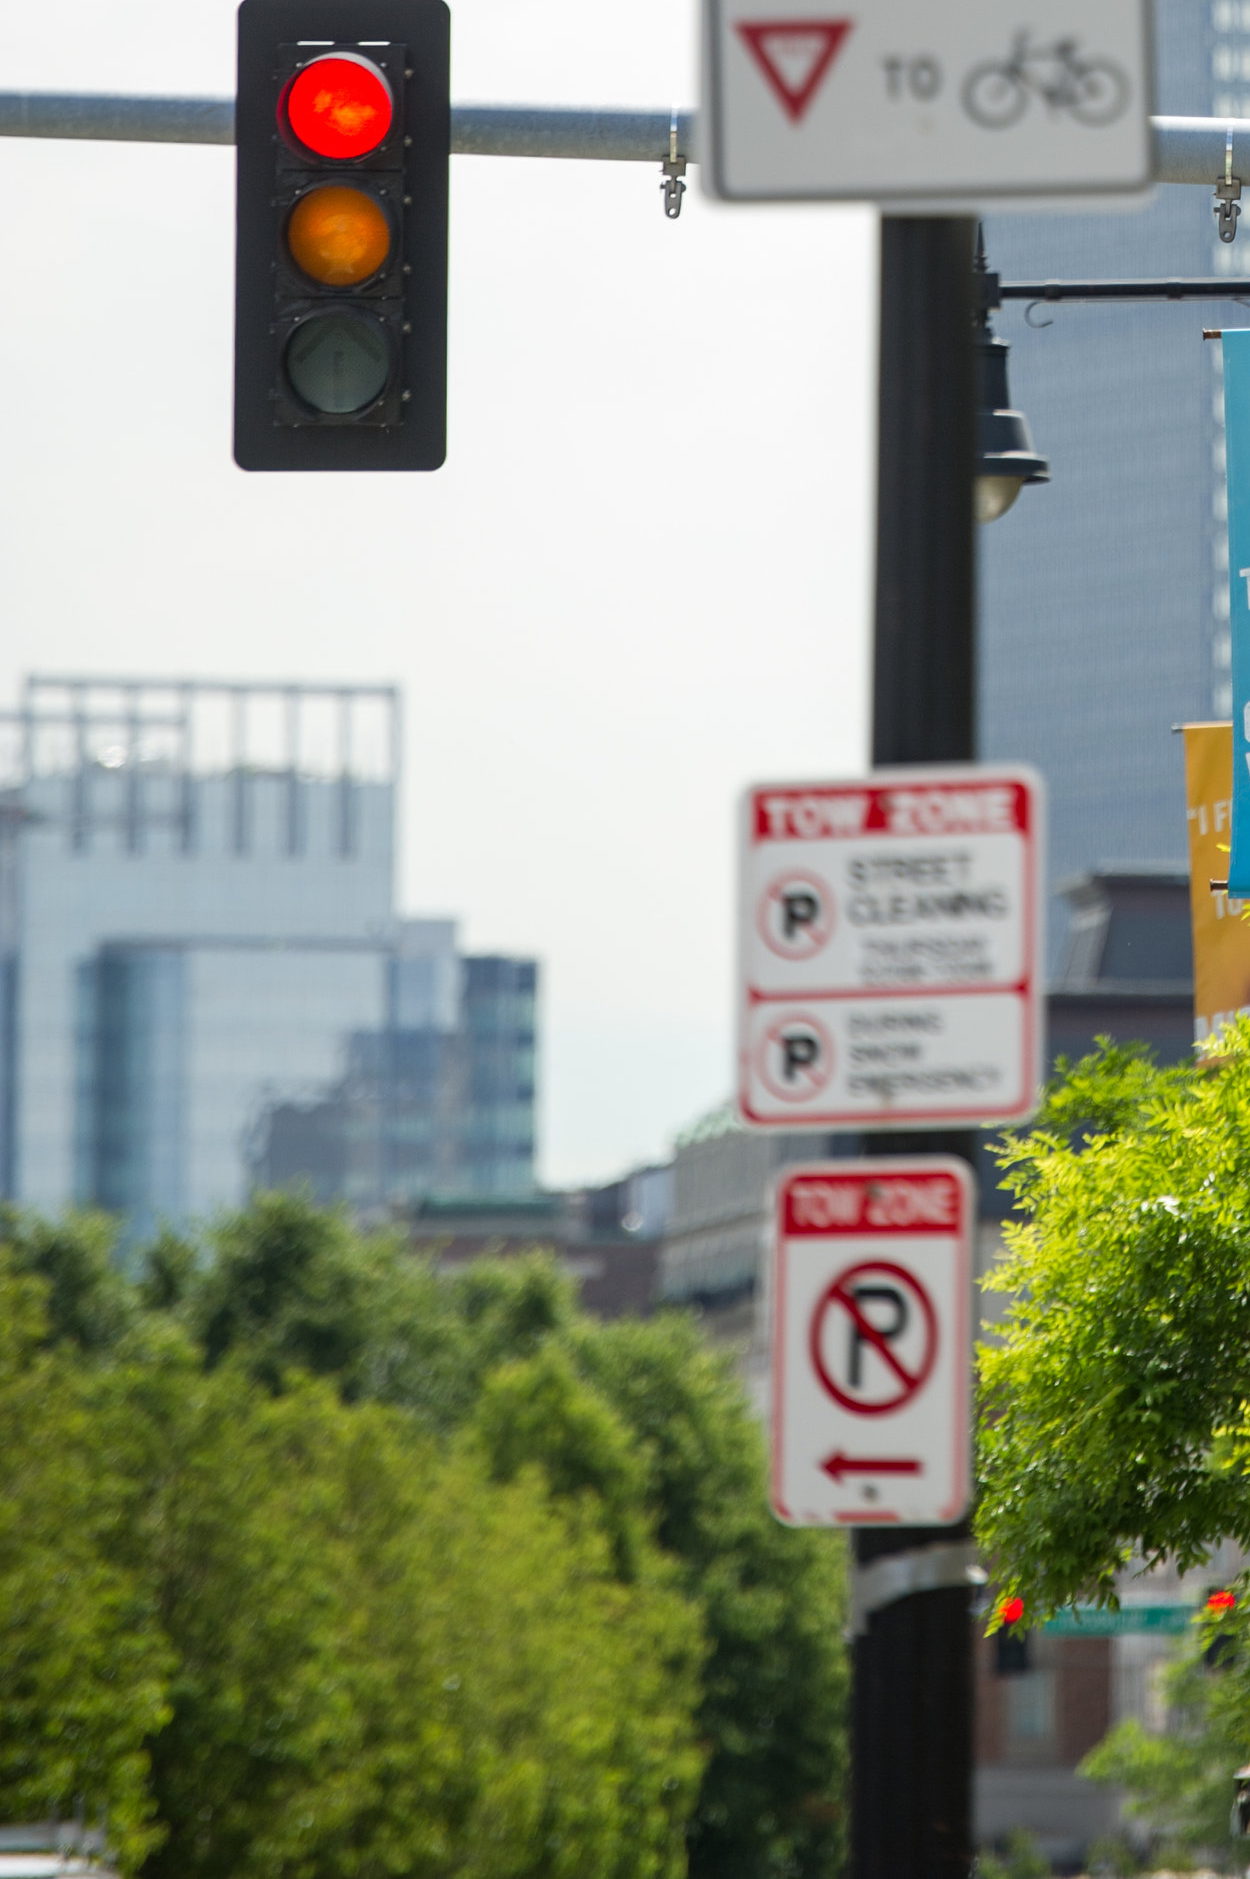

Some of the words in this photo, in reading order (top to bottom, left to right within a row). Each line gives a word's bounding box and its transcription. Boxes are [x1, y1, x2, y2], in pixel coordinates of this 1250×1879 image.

[881, 55, 941, 102] TO
[763, 794, 867, 838] TOW
[886, 790, 1012, 833] ZONE
[791, 1179, 860, 1229] TOW
[865, 1177, 958, 1227] ZONE
